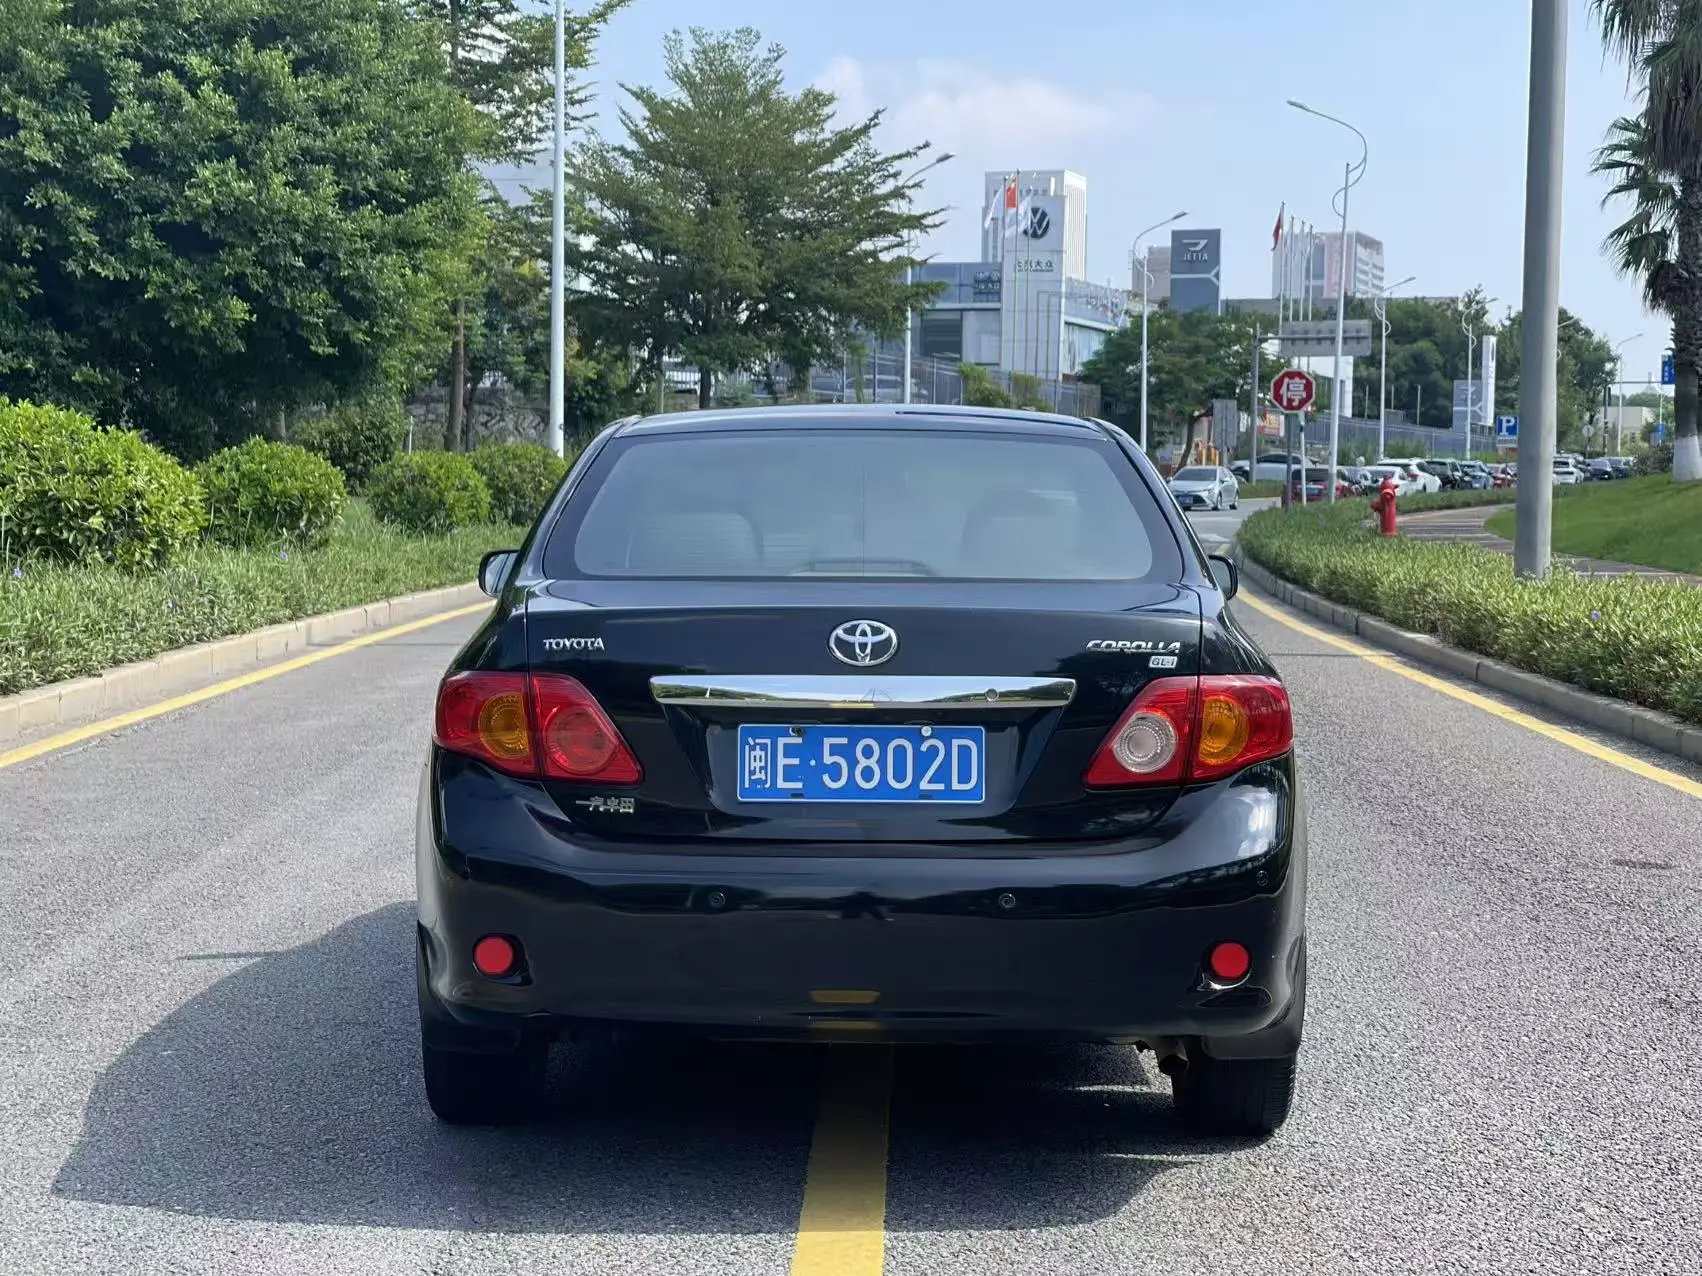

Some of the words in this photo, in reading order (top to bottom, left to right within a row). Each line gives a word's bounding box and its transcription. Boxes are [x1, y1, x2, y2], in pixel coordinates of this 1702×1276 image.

[1280, 376, 1306, 407] 停
[1500, 416, 1515, 436] P
[542, 637, 605, 651] TOYOTA
[1086, 640, 1180, 654] COROLLA
